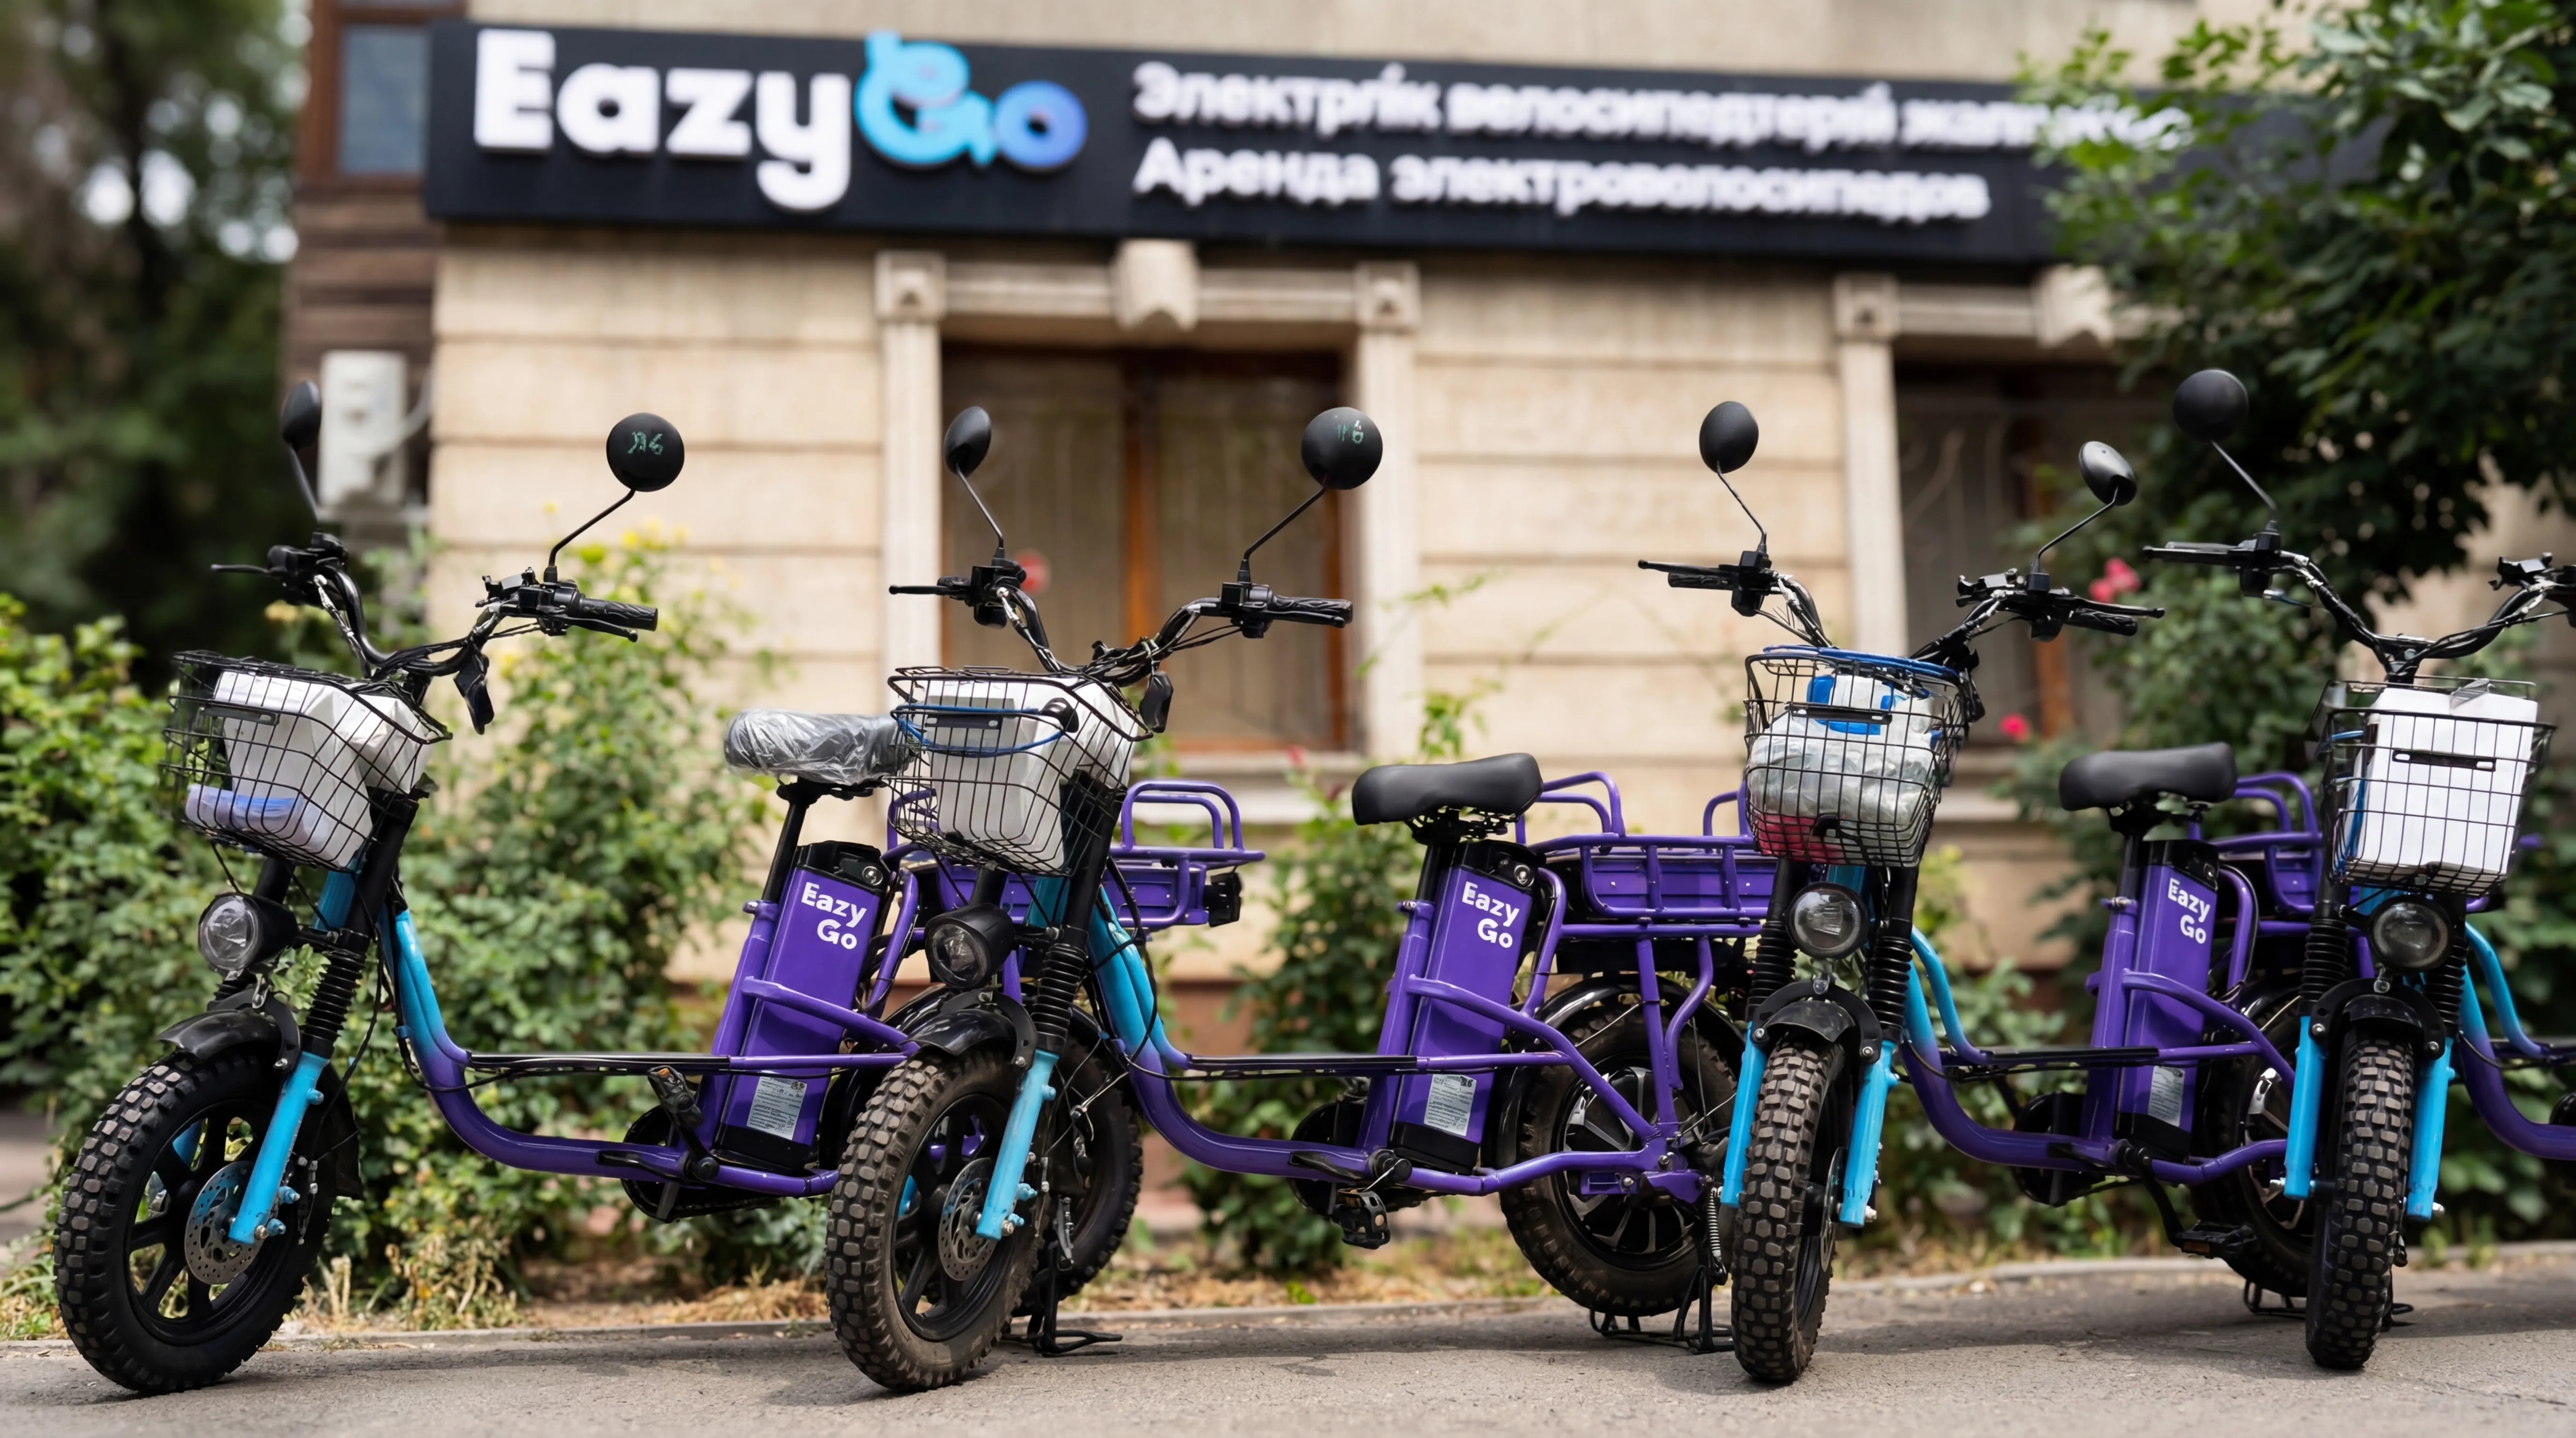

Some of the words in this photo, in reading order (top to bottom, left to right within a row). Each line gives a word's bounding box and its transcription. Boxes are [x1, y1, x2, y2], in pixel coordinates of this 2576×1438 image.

[1133, 137, 1380, 207] Аренда
[1389, 154, 1991, 224] электровелосипедов
[801, 881, 867, 928] Eazy
[1462, 880, 1520, 927] Eazy
[2167, 877, 2211, 923] Eazy
[817, 918, 857, 950] Go
[1477, 917, 1513, 948] Go
[2180, 914, 2207, 944] Go
